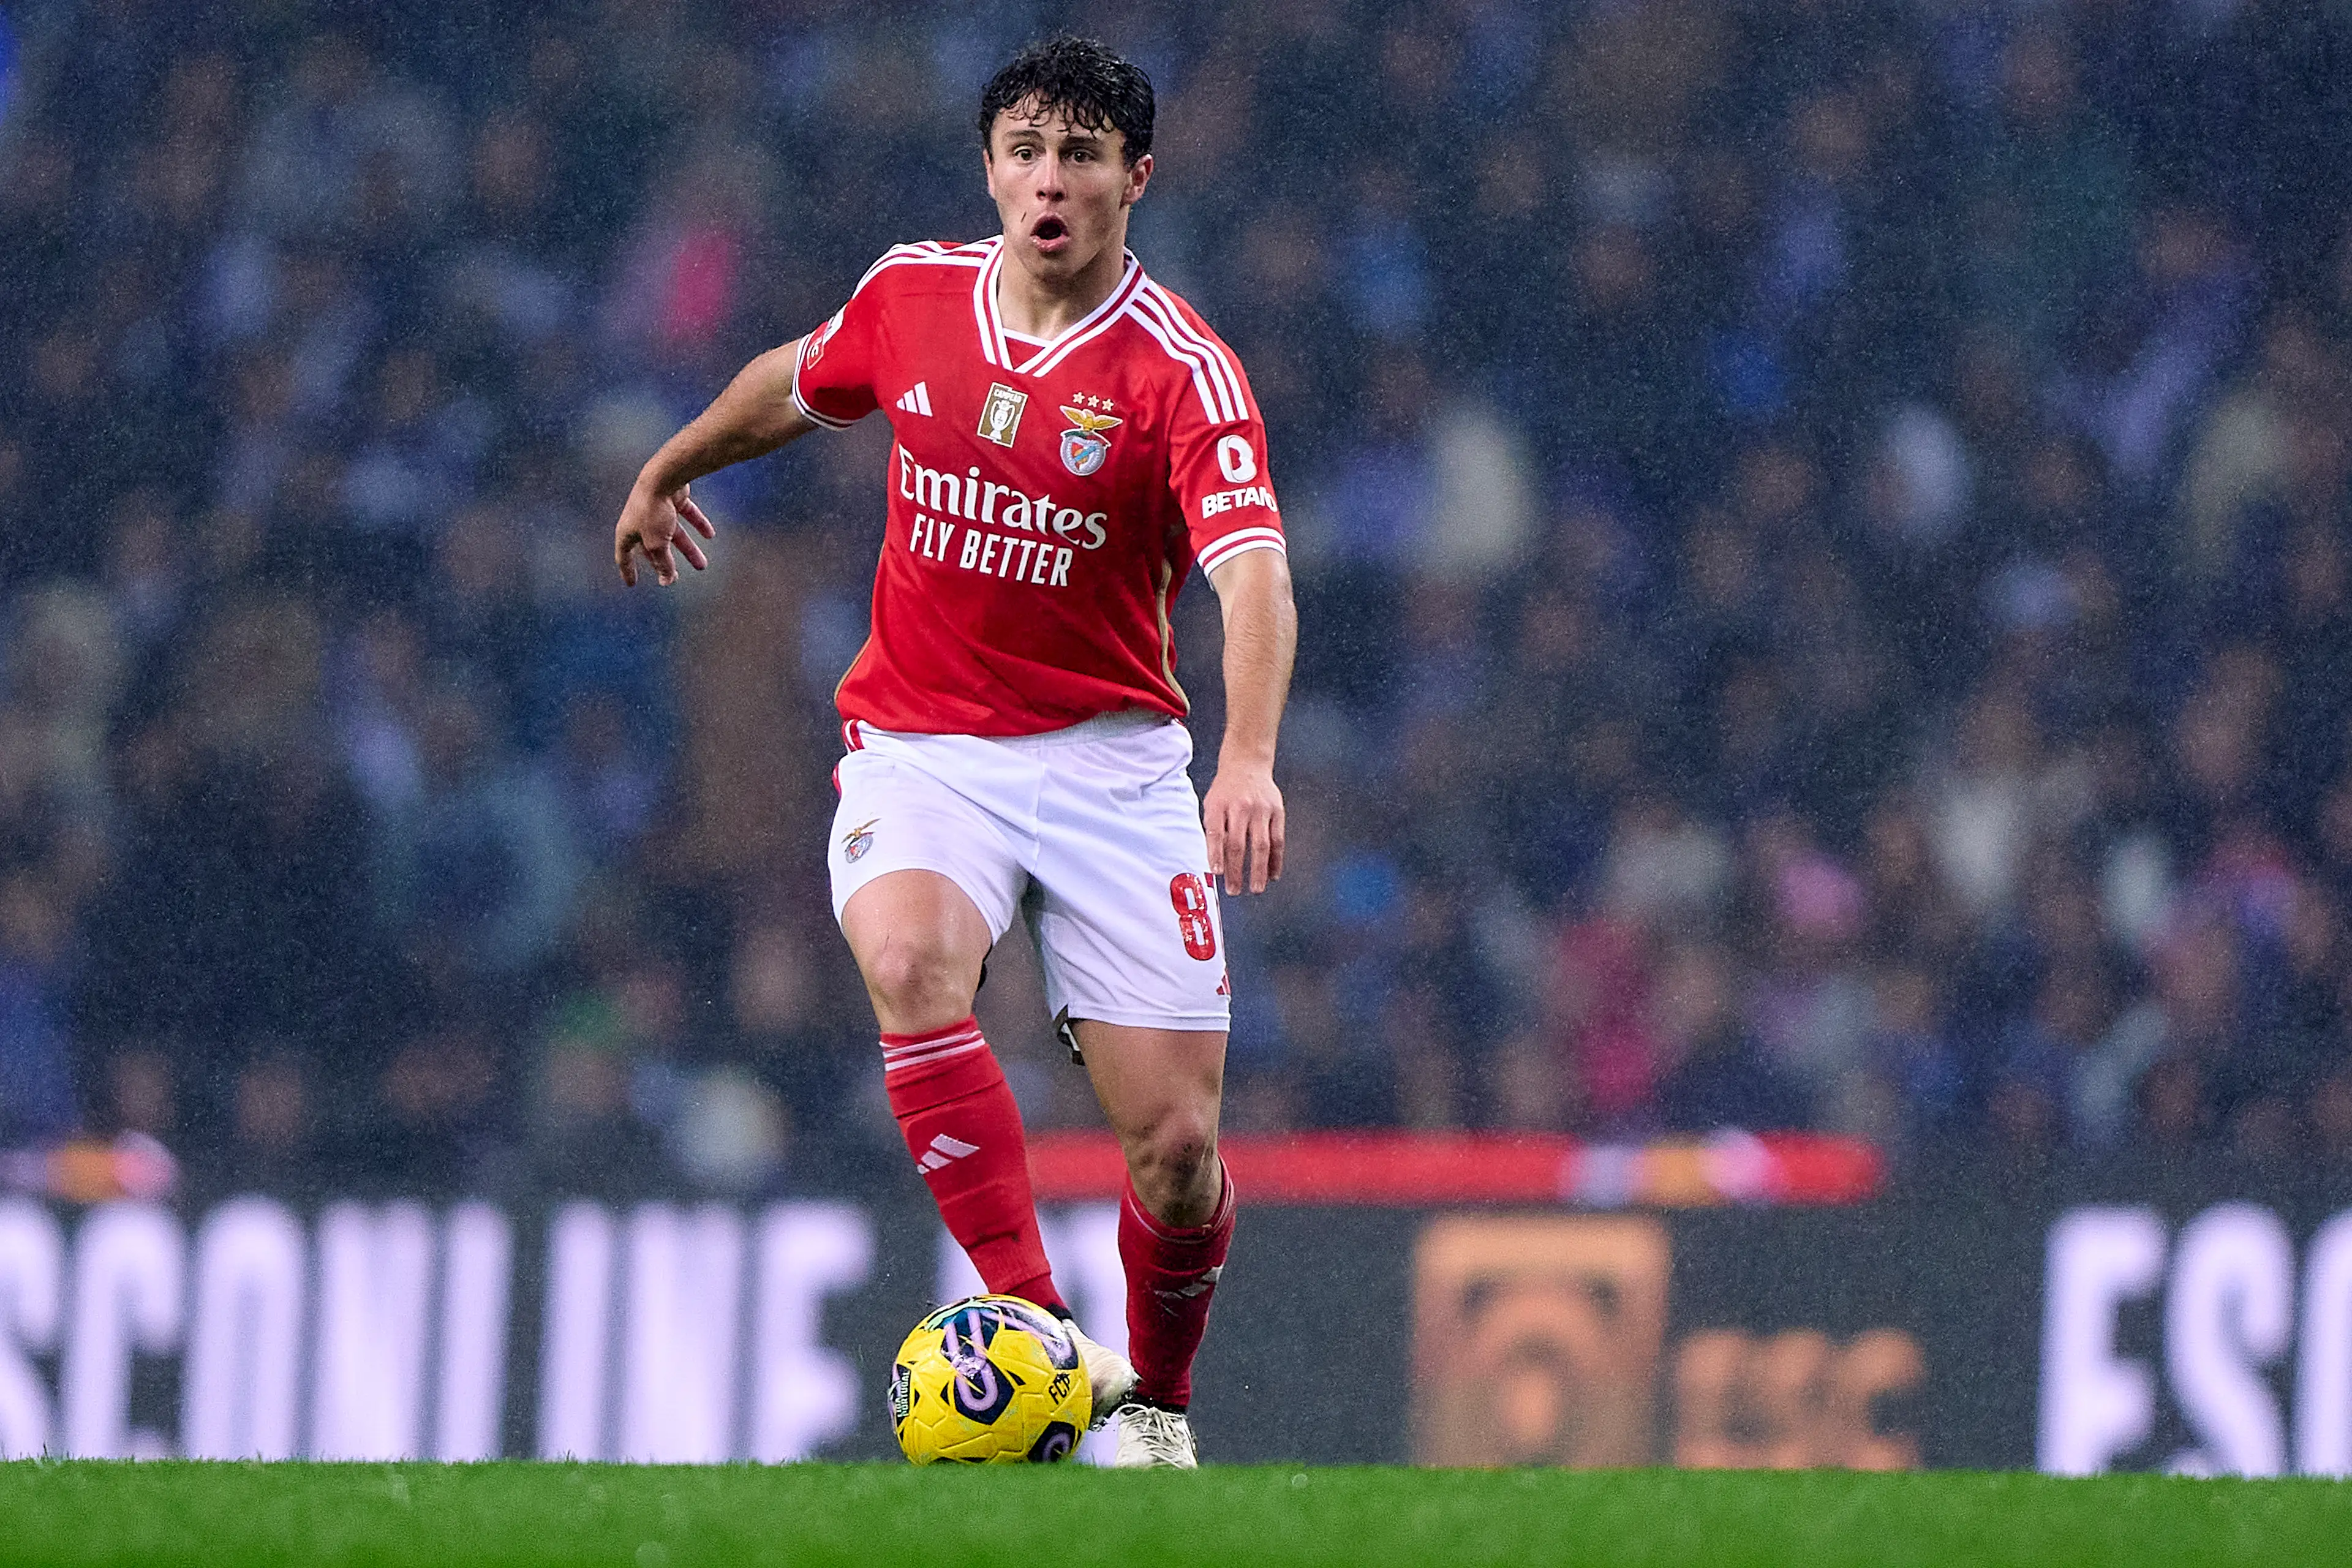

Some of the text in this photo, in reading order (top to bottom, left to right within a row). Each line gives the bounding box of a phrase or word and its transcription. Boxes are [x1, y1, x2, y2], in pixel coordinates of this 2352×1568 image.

[899, 443, 1107, 550] Emirates
[910, 513, 1073, 587] FLY BETTER
[1169, 872, 1216, 961] 8
